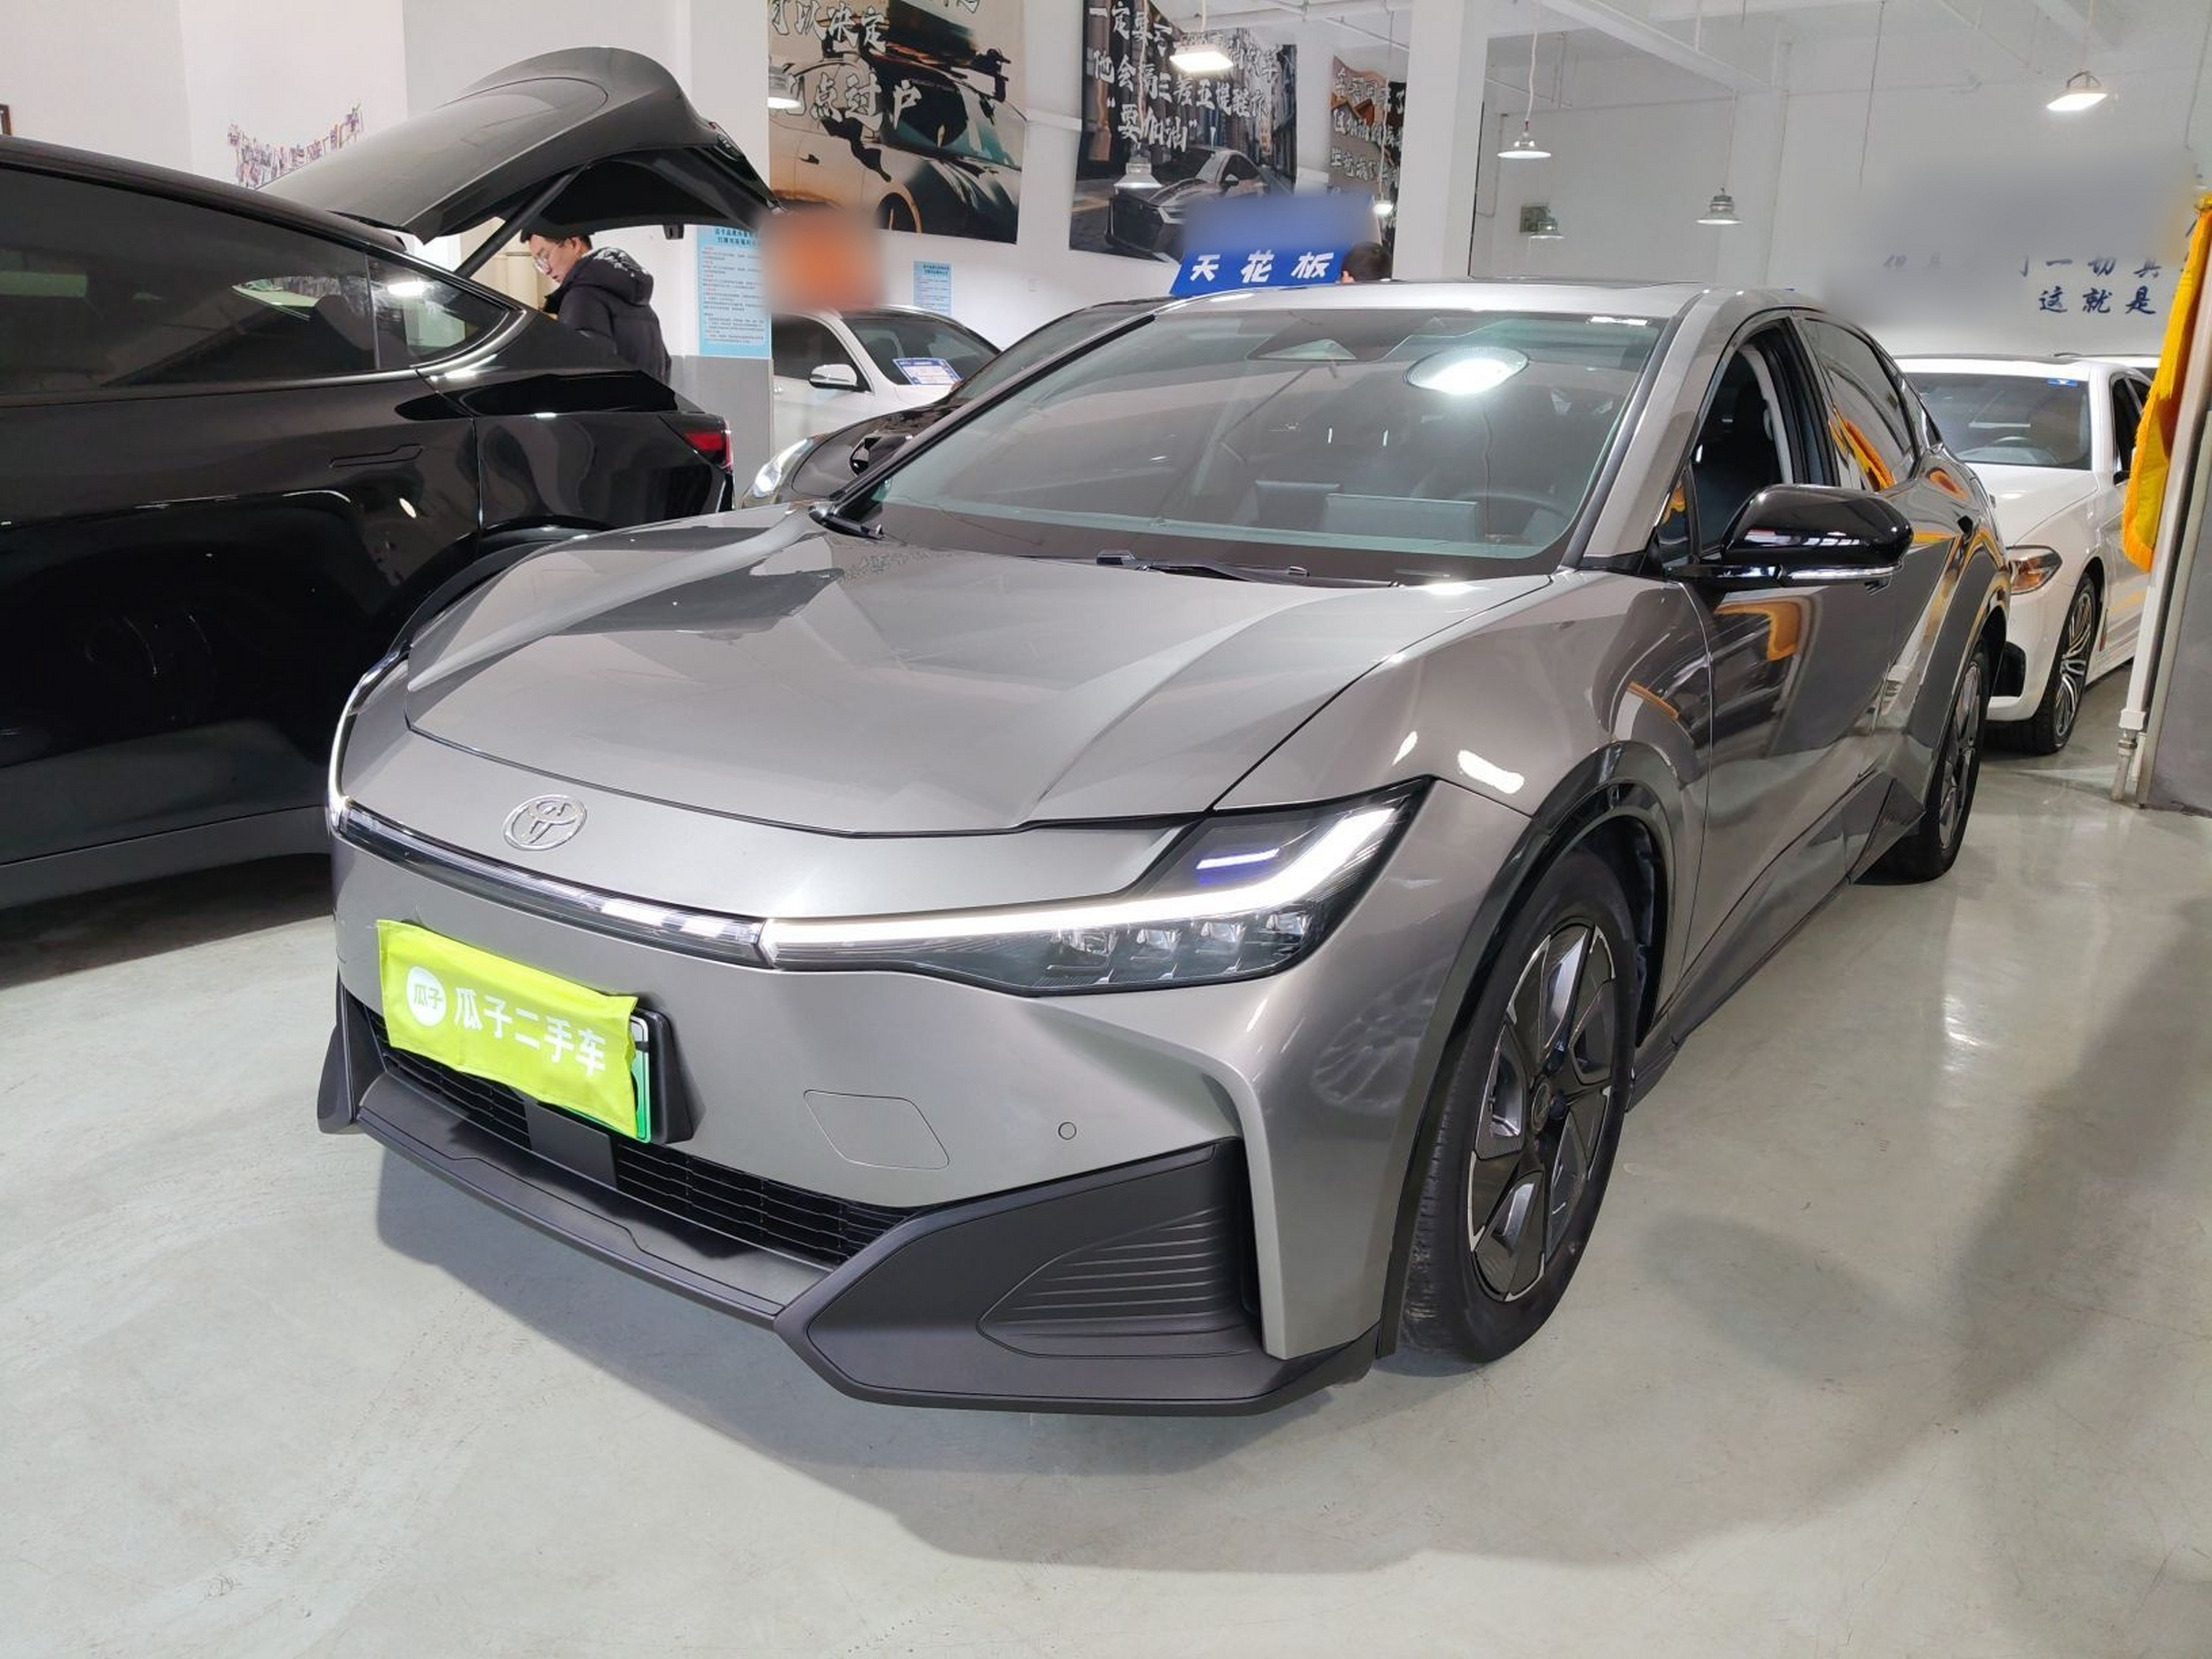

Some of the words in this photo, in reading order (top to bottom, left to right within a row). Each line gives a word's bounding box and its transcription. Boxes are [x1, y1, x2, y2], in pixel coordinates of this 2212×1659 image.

[1190, 249, 1334, 283] 天花板
[2039, 286, 2156, 315] 这就是
[414, 983, 443, 1010] 瓜子
[453, 987, 606, 1077] 瓜子二手车
